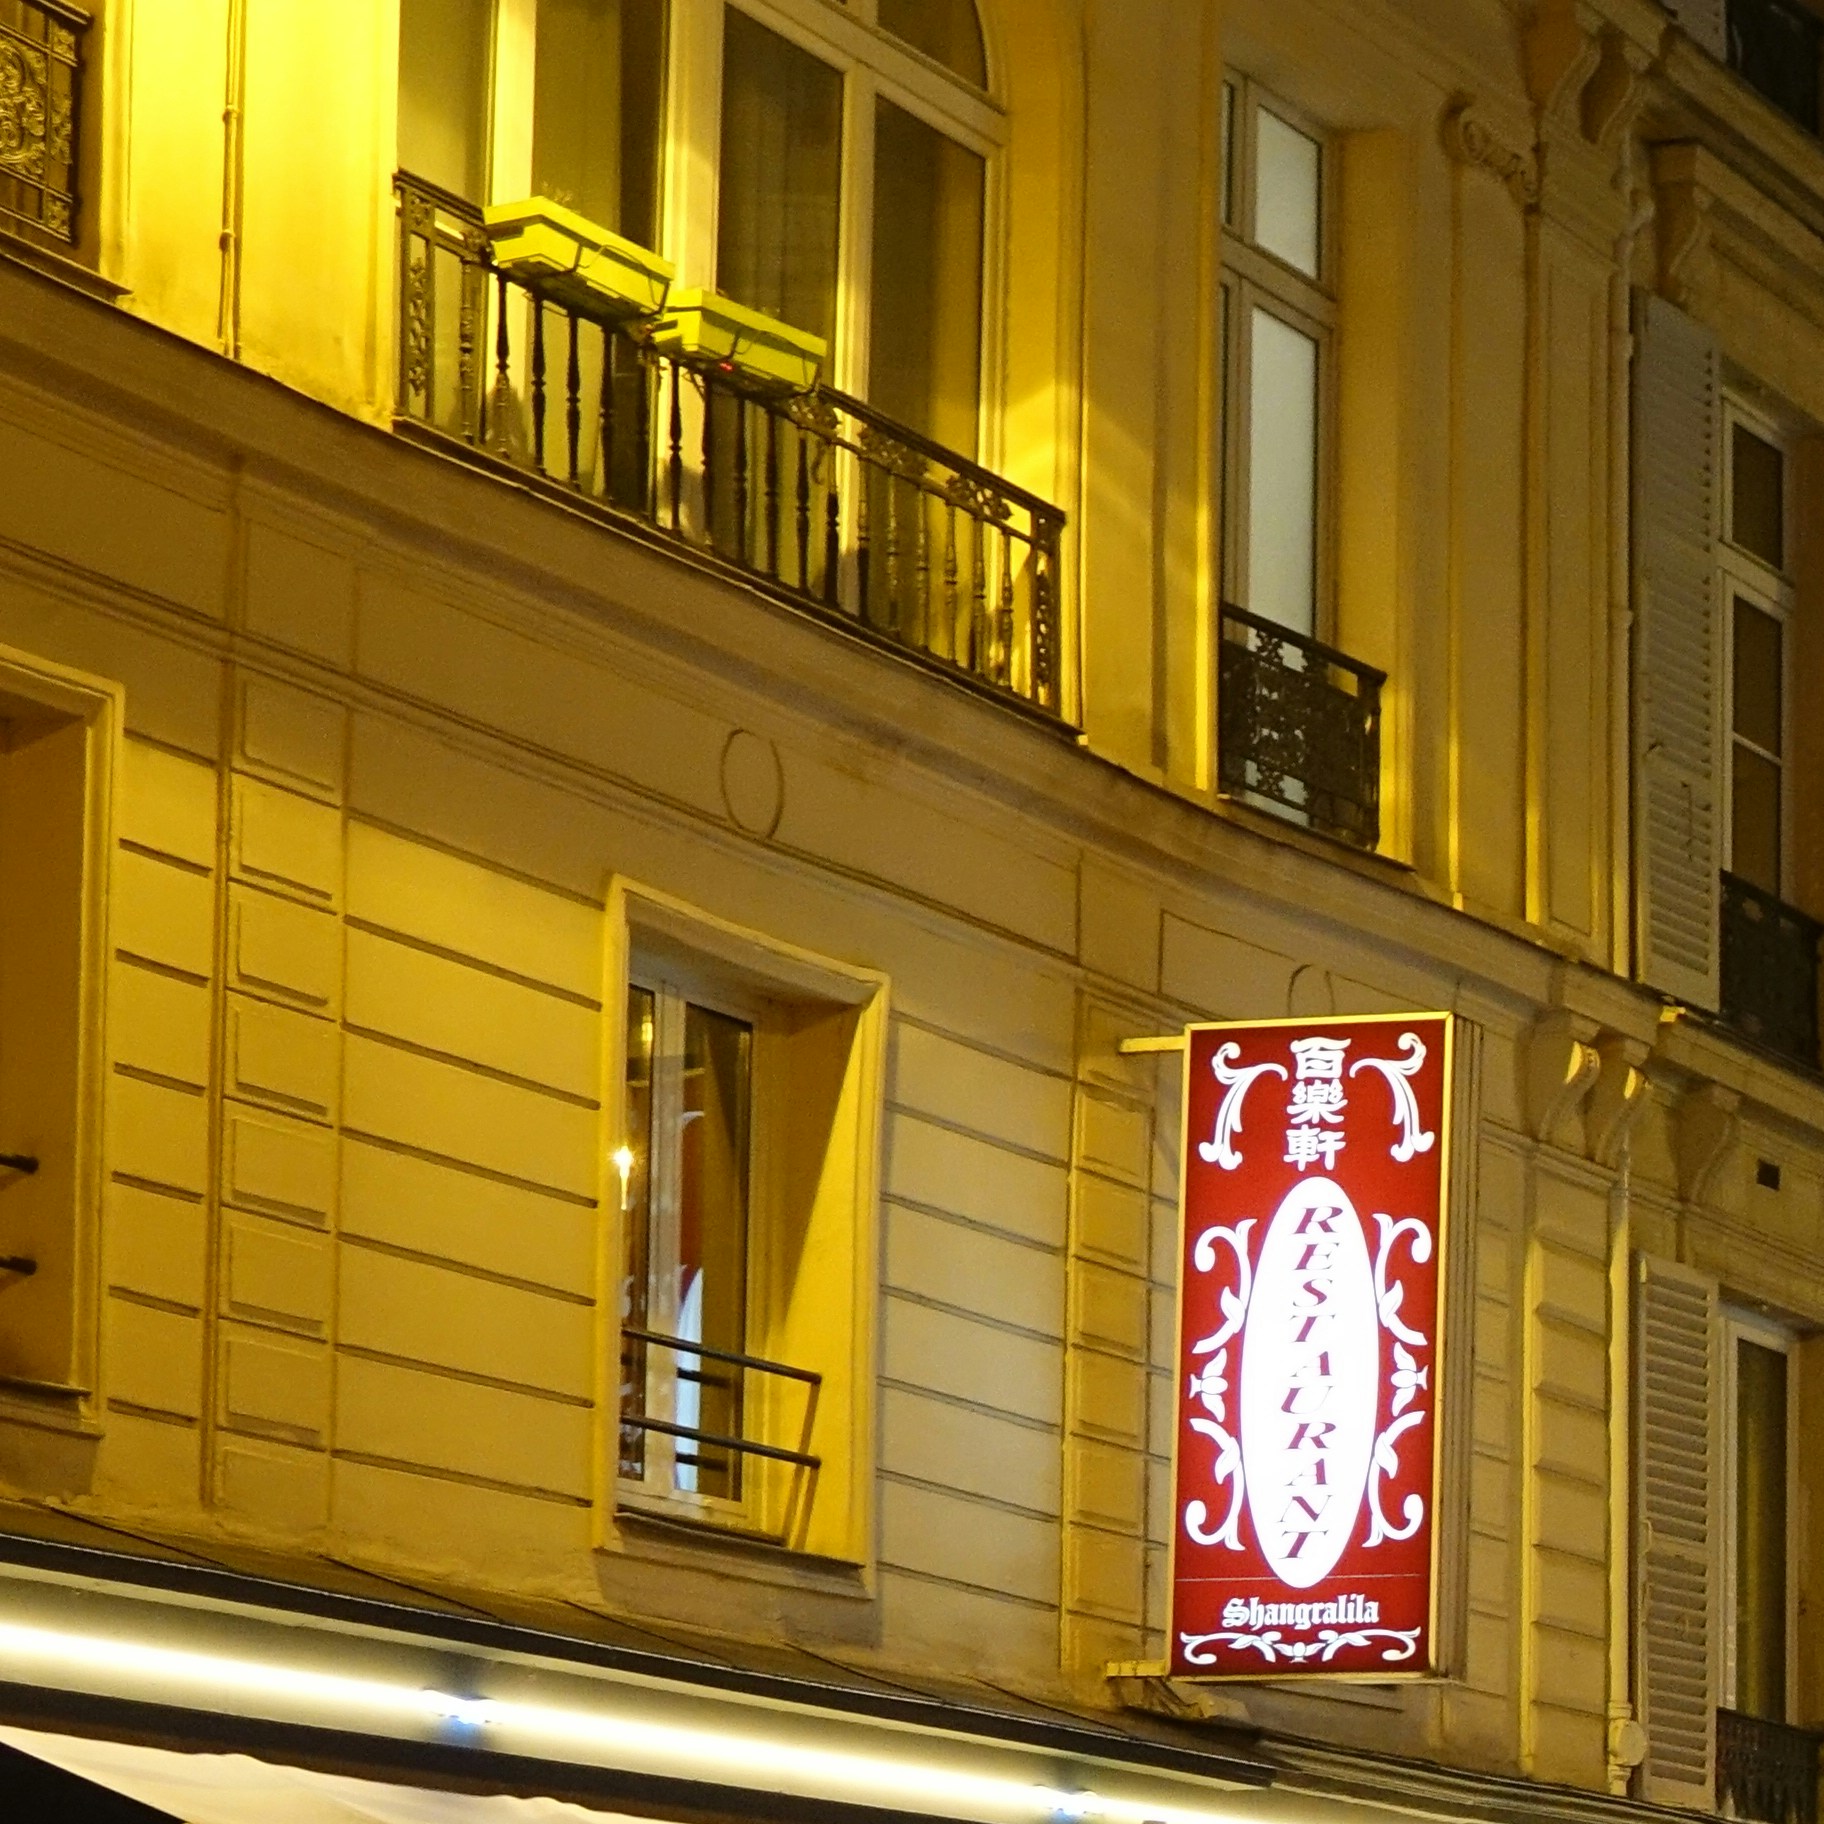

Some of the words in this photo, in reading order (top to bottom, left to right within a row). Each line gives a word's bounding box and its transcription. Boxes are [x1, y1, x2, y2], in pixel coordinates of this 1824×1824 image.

[1284, 1036, 1352, 1172] 百樂軒
[1279, 1205, 1344, 1562] RESTAURANT
[1221, 1595, 1380, 1630] Shangralila
